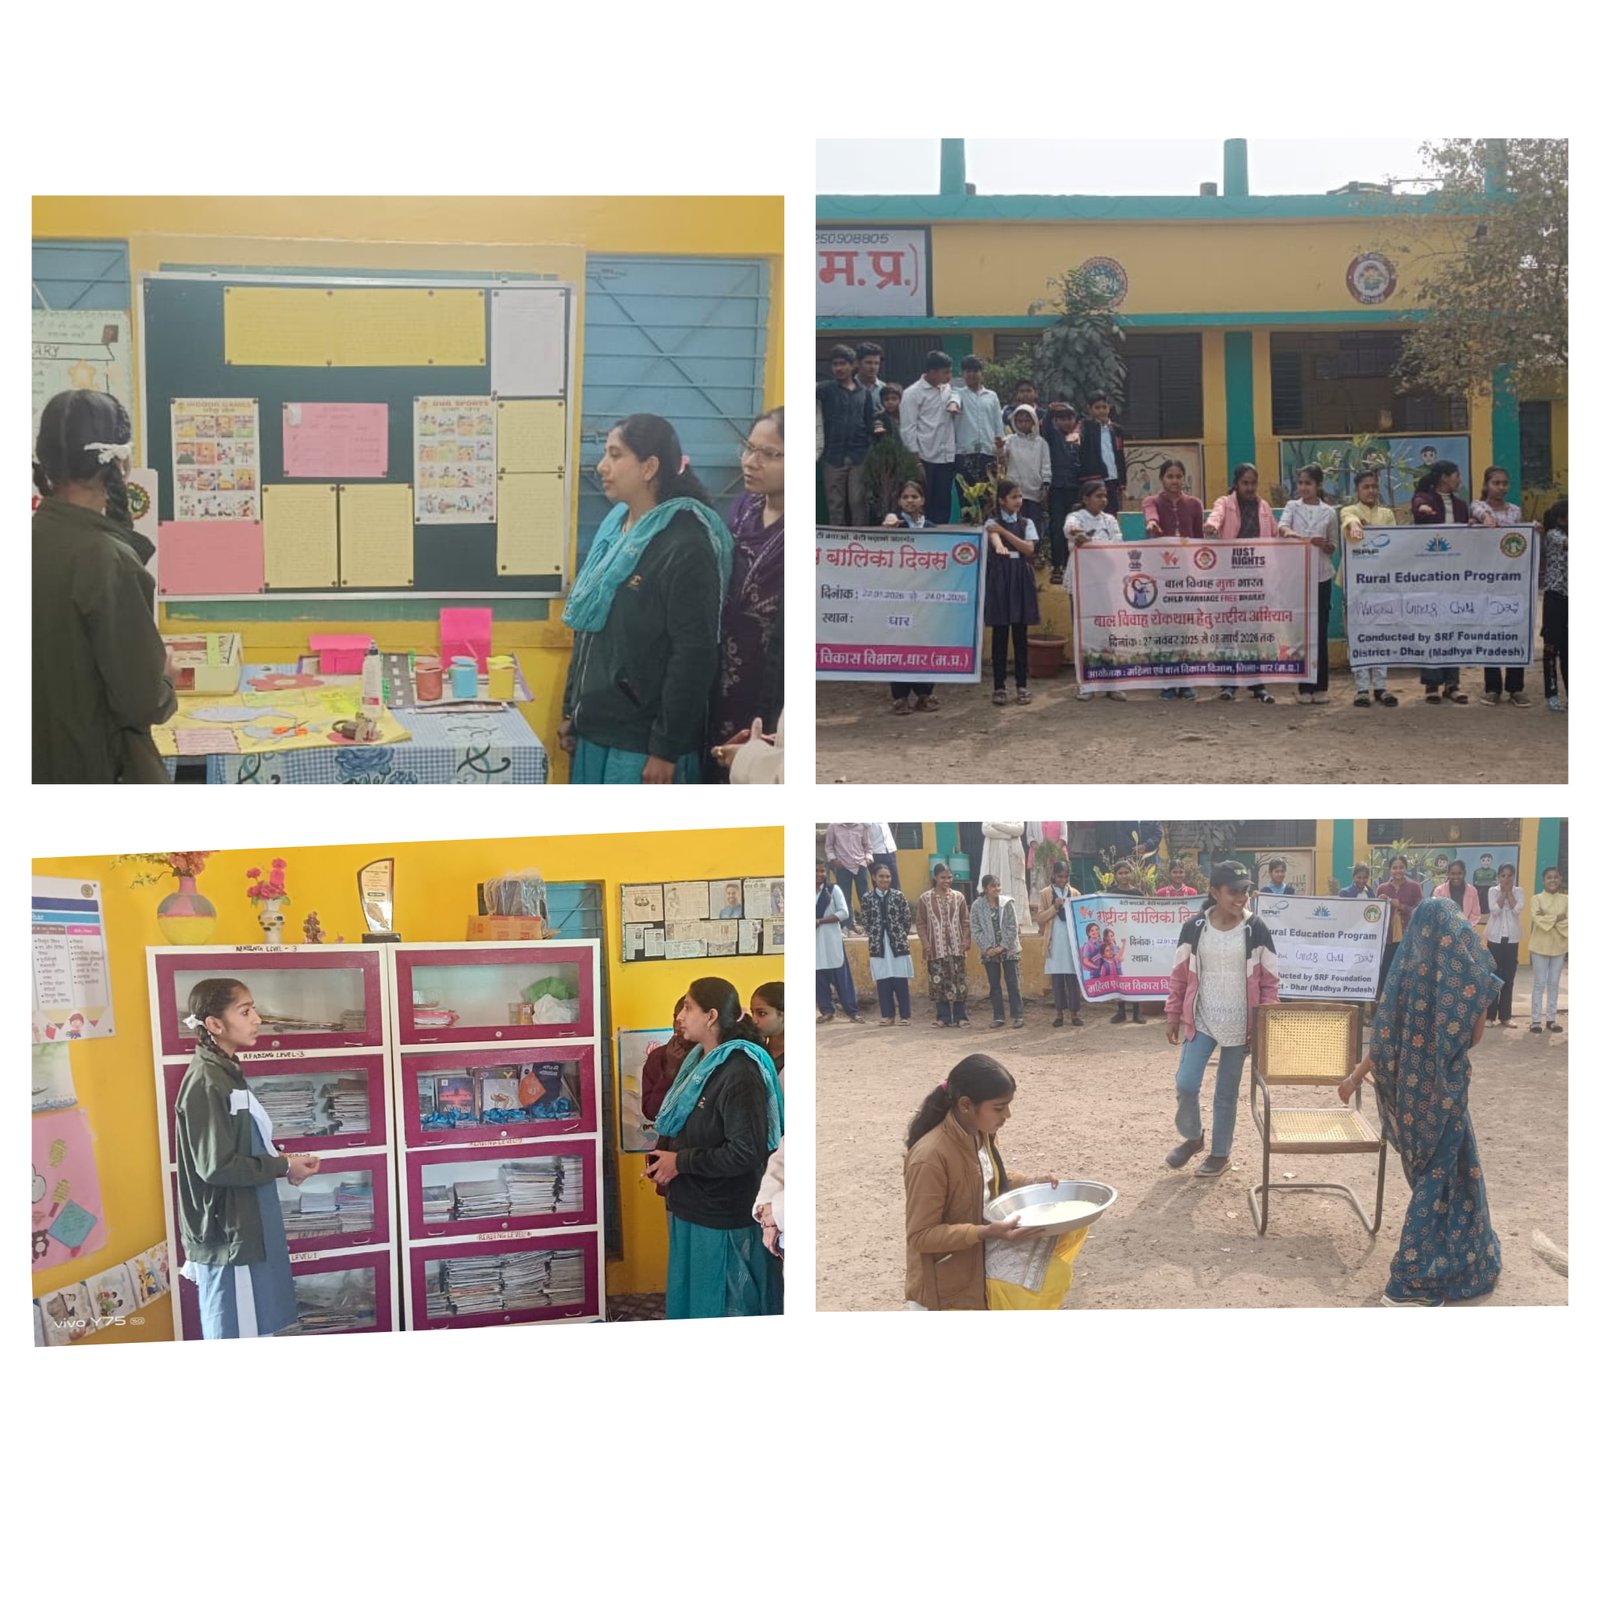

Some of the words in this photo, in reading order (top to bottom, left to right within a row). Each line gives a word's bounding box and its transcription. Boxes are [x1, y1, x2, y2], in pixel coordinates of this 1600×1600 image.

[826, 542, 895, 568] बालिका
[899, 544, 948, 571] दिवस
[1231, 547, 1255, 556] JUST
[1231, 556, 1265, 565] RIGHTS
[1164, 579, 1183, 588] बाल
[1186, 576, 1213, 589] विवाह
[1356, 572, 1391, 584] Rural
[1395, 571, 1460, 583] Education
[1464, 570, 1522, 583] Program
[1162, 595, 1183, 603] CHILD
[888, 615, 910, 626] धार
[1094, 615, 1116, 627] बाल
[1118, 610, 1149, 628] विवाह
[1151, 608, 1194, 625] रोकथाम
[1197, 608, 1213, 629] हेतु
[1249, 606, 1292, 623] अभियान
[1358, 632, 1415, 643] Conducted
[1418, 632, 1431, 644] by
[1435, 631, 1454, 641] SRF
[1457, 631, 1518, 641] Foundation
[820, 647, 860, 664] विकास
[1352, 648, 1391, 658] District
[1400, 647, 1425, 656] Dhar
[1428, 647, 1472, 658] (Madhya
[1476, 646, 1525, 659] Pradesh)
[1132, 907, 1175, 924] बालिका
[1289, 929, 1335, 939] Education
[1338, 931, 1377, 941] Program
[1303, 972, 1312, 981] by
[1314, 972, 1329, 980] SRF
[1331, 974, 1371, 982] Foundation
[1132, 979, 1159, 990] विकास
[1310, 984, 1341, 993] (Madhya
[1343, 984, 1376, 994] Pradesh)
